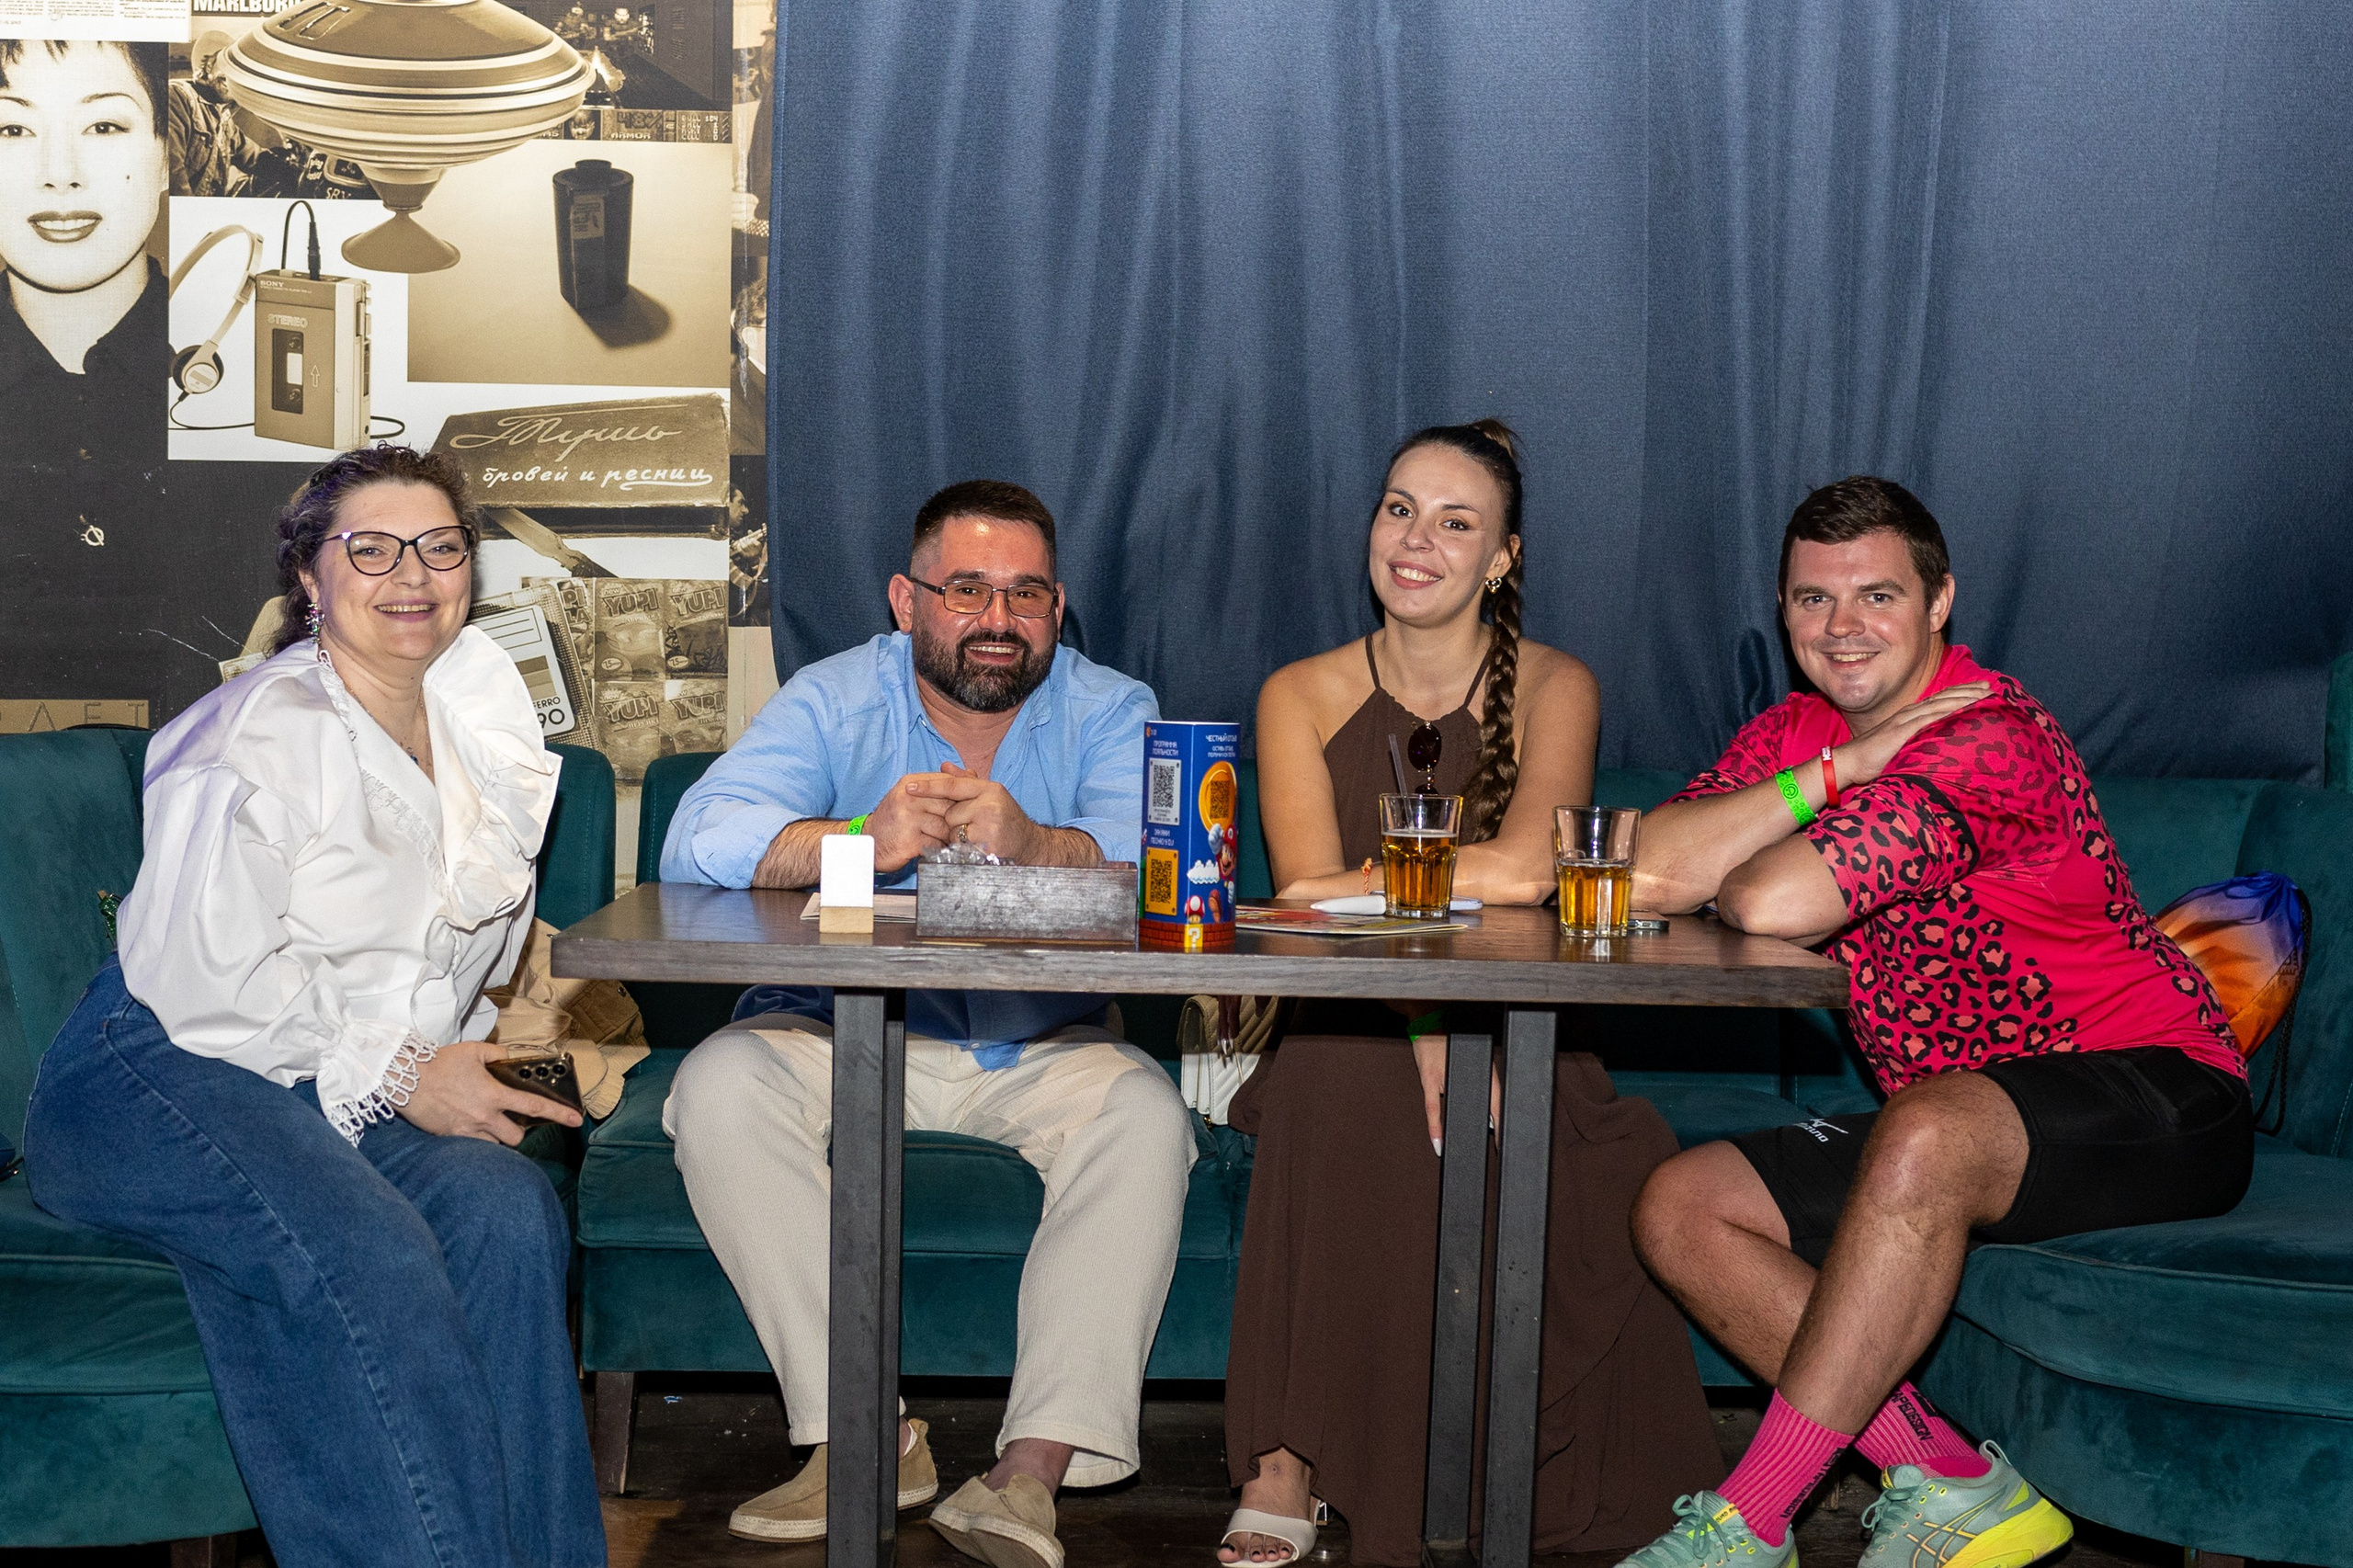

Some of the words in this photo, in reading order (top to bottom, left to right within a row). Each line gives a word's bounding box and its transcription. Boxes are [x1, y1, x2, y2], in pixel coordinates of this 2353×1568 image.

[610, 131, 652, 140] ARMOR
[260, 279, 284, 288] SONY
[267, 313, 309, 328] STEREO
[449, 403, 689, 462] Тушь
[483, 465, 567, 488] бровей
[579, 471, 597, 482] и
[600, 466, 713, 491] ресниц
[602, 588, 660, 617] YUPI
[603, 586, 620, 596] new
[670, 586, 725, 616] YUPI
[603, 696, 659, 722] YUPI
[669, 691, 724, 719] YUPI
[537, 708, 565, 729] 90
[1890, 1391, 1934, 1441] APEDESIGN
